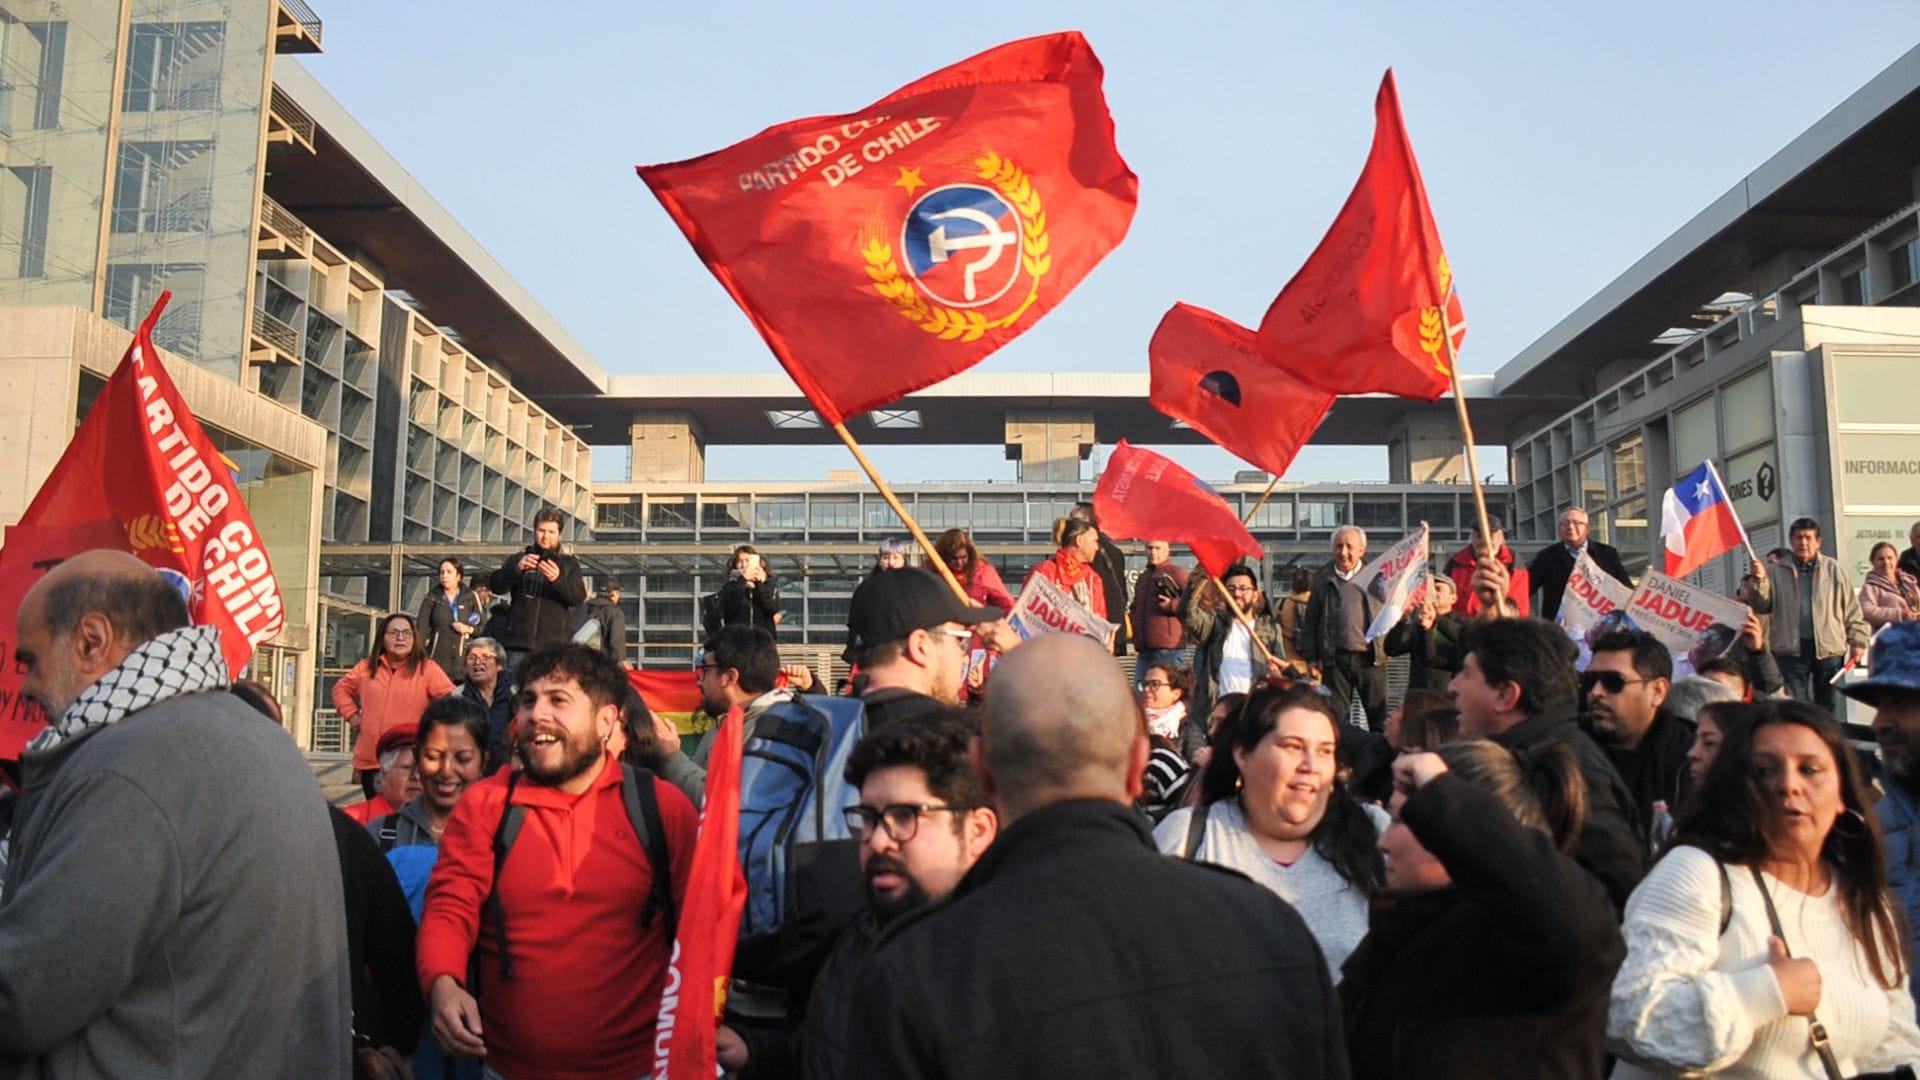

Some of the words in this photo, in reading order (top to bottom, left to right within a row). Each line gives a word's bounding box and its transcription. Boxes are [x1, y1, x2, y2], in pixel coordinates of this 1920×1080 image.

[737, 135, 841, 192] PARTIDO
[821, 153, 863, 188] DE
[862, 117, 941, 163] CHILE
[165, 481, 212, 542] DE
[1569, 573, 1617, 615] ADUE
[1634, 588, 1714, 633] JADUE
[1647, 577, 1691, 604] DANIEL
